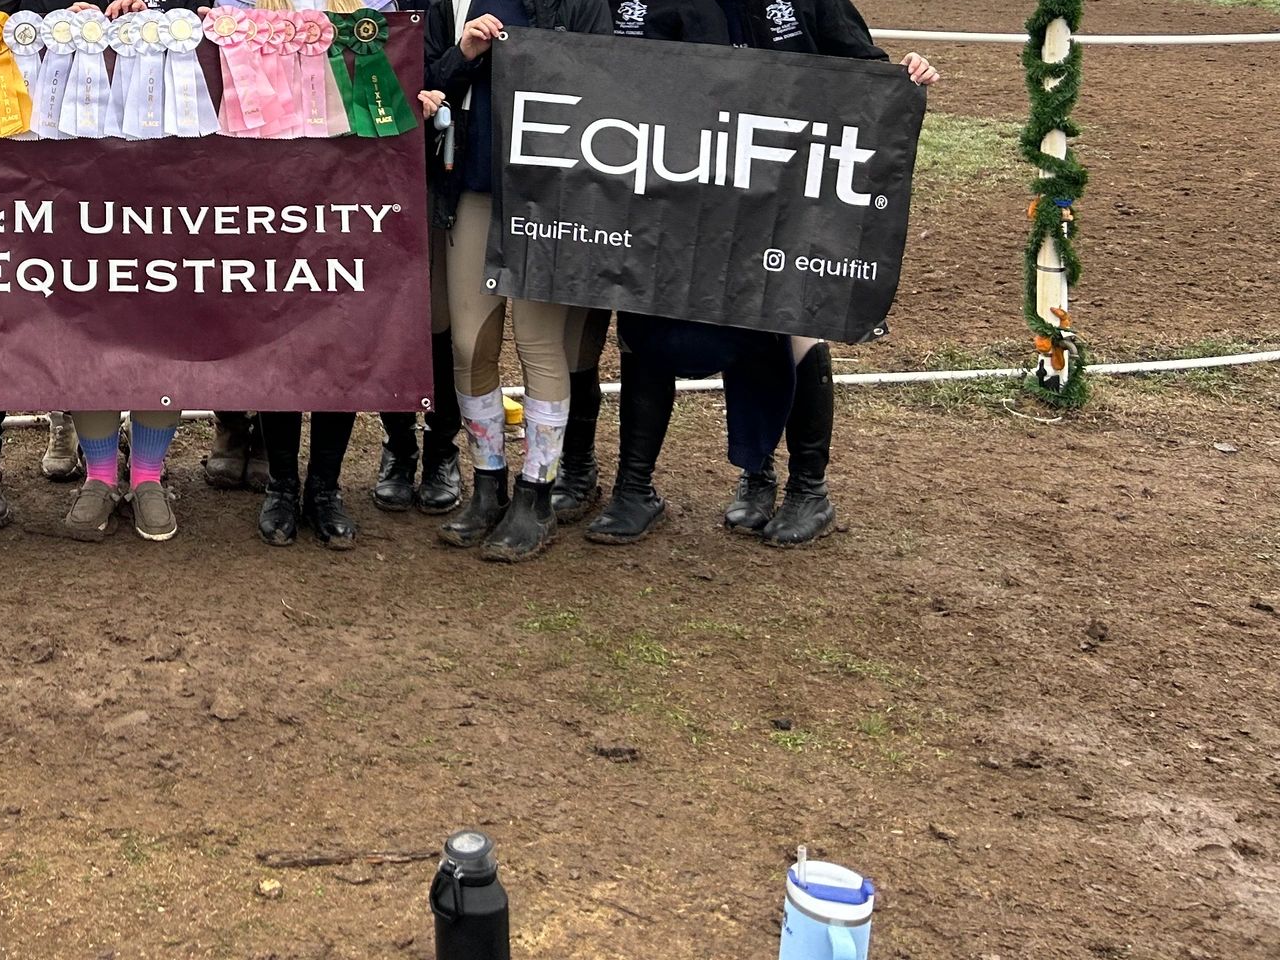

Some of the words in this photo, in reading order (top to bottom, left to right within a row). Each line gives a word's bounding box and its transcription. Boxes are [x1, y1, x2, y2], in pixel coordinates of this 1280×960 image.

[48, 70, 59, 119] FOURTH
[372, 75, 385, 116] SIXTH
[510, 216, 633, 248] EquiFit.net
[795, 255, 878, 281] equifit1
